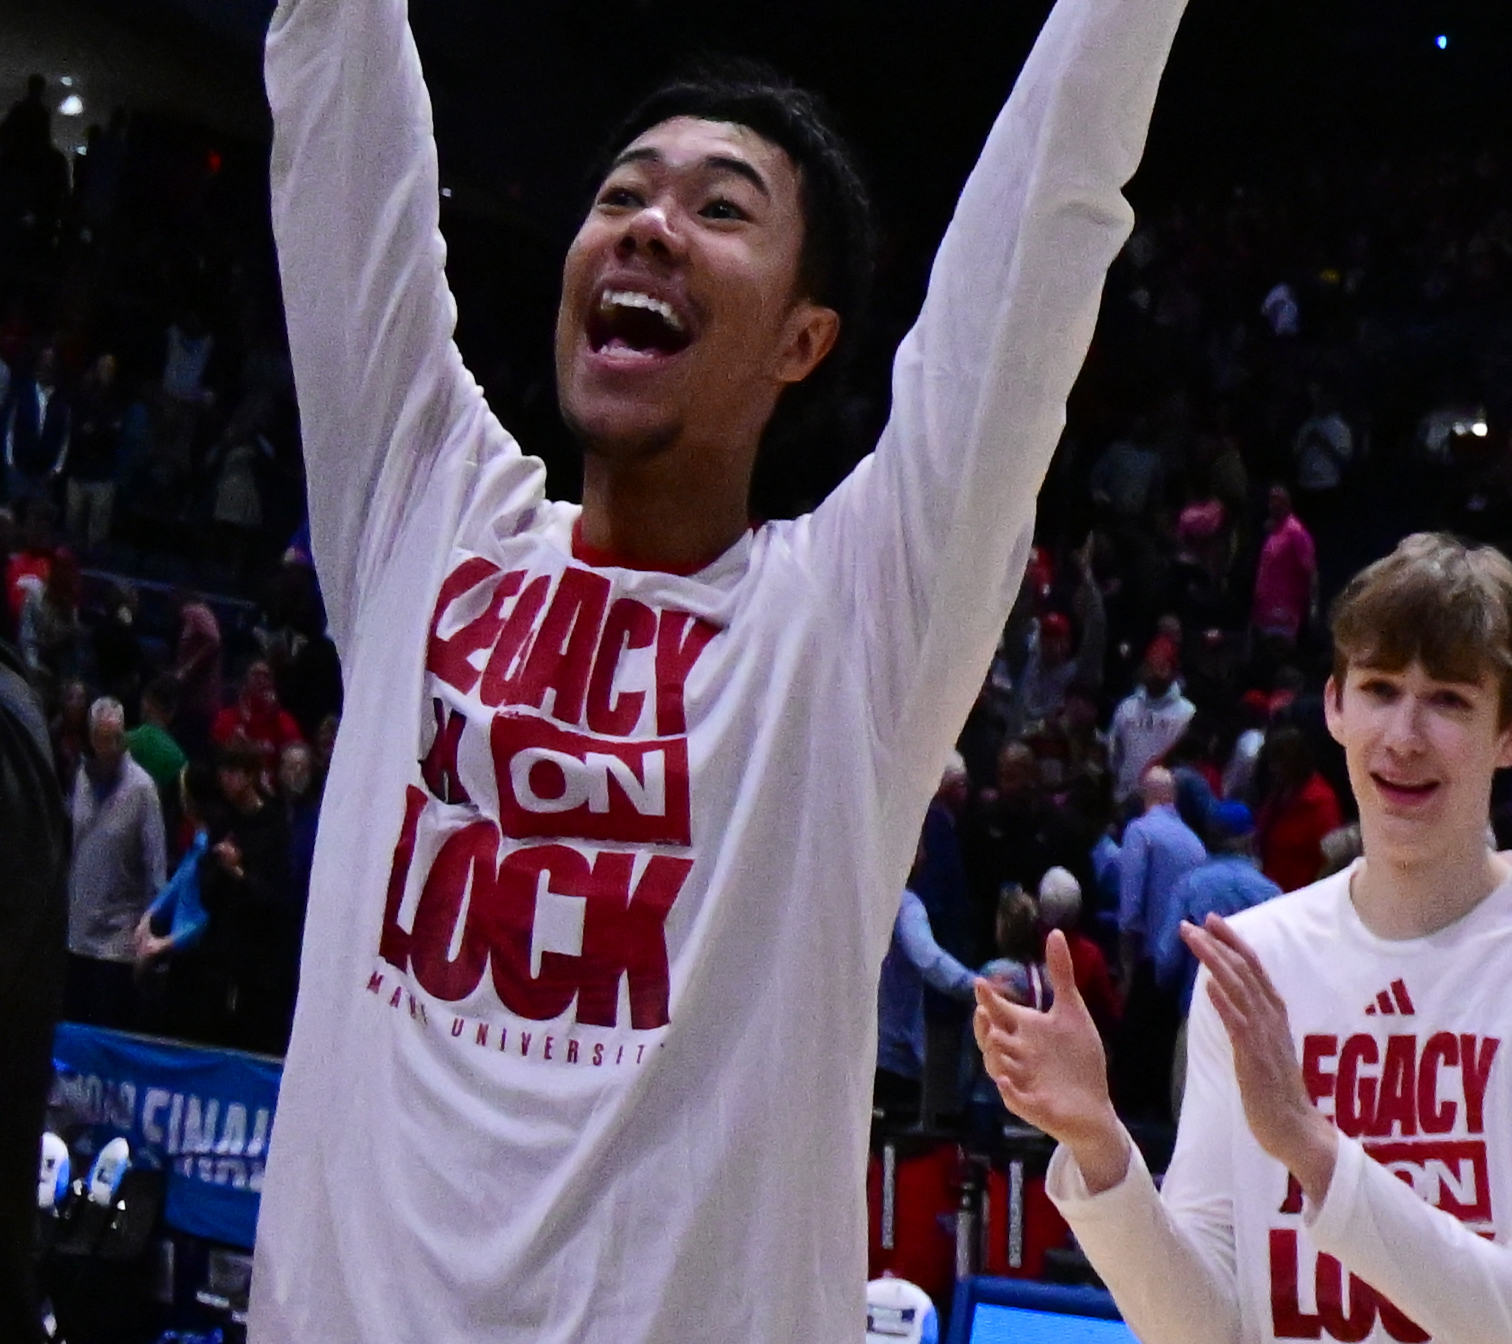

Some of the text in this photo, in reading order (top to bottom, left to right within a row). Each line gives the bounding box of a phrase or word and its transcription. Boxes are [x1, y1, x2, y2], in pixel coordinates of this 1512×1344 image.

[508, 747, 667, 817] ON
[379, 783, 695, 1030] LOCK
[450, 1017, 665, 1067] UNIVERSIT
[1302, 1032, 1501, 1138] EGACY
